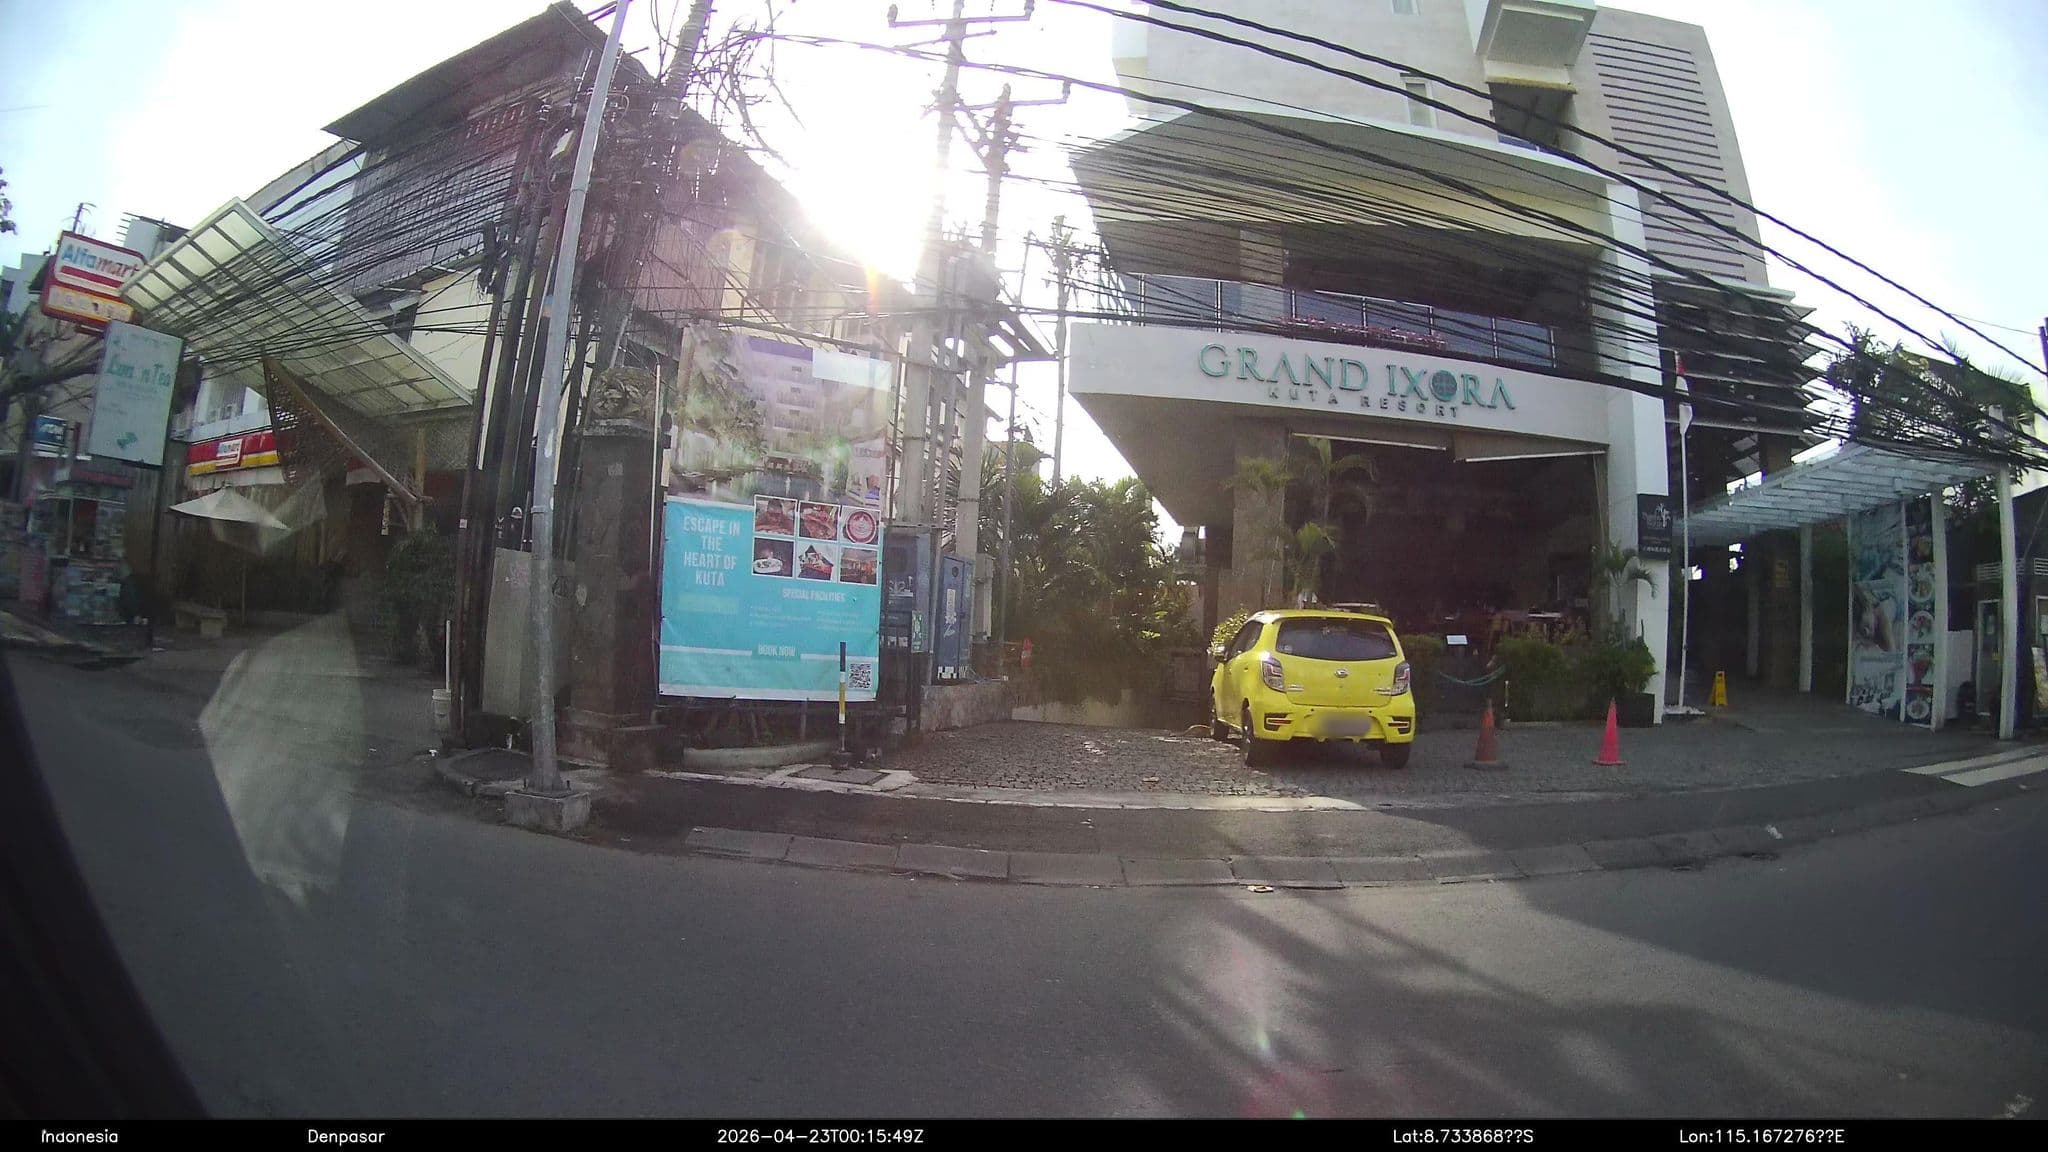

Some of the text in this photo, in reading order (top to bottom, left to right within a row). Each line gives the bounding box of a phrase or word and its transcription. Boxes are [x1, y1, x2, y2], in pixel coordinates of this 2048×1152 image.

[62, 244, 140, 278] Alfamart
[1198, 343, 1517, 410] GRAND IXORA
[1267, 385, 1459, 419] KUTA RESORT
[683, 516, 741, 536] ESCAPE IN
[702, 536, 722, 552] THE
[683, 552, 737, 570] HEART OF
[695, 573, 725, 587] KUTA
[758, 644, 796, 658] BOOK NOW
